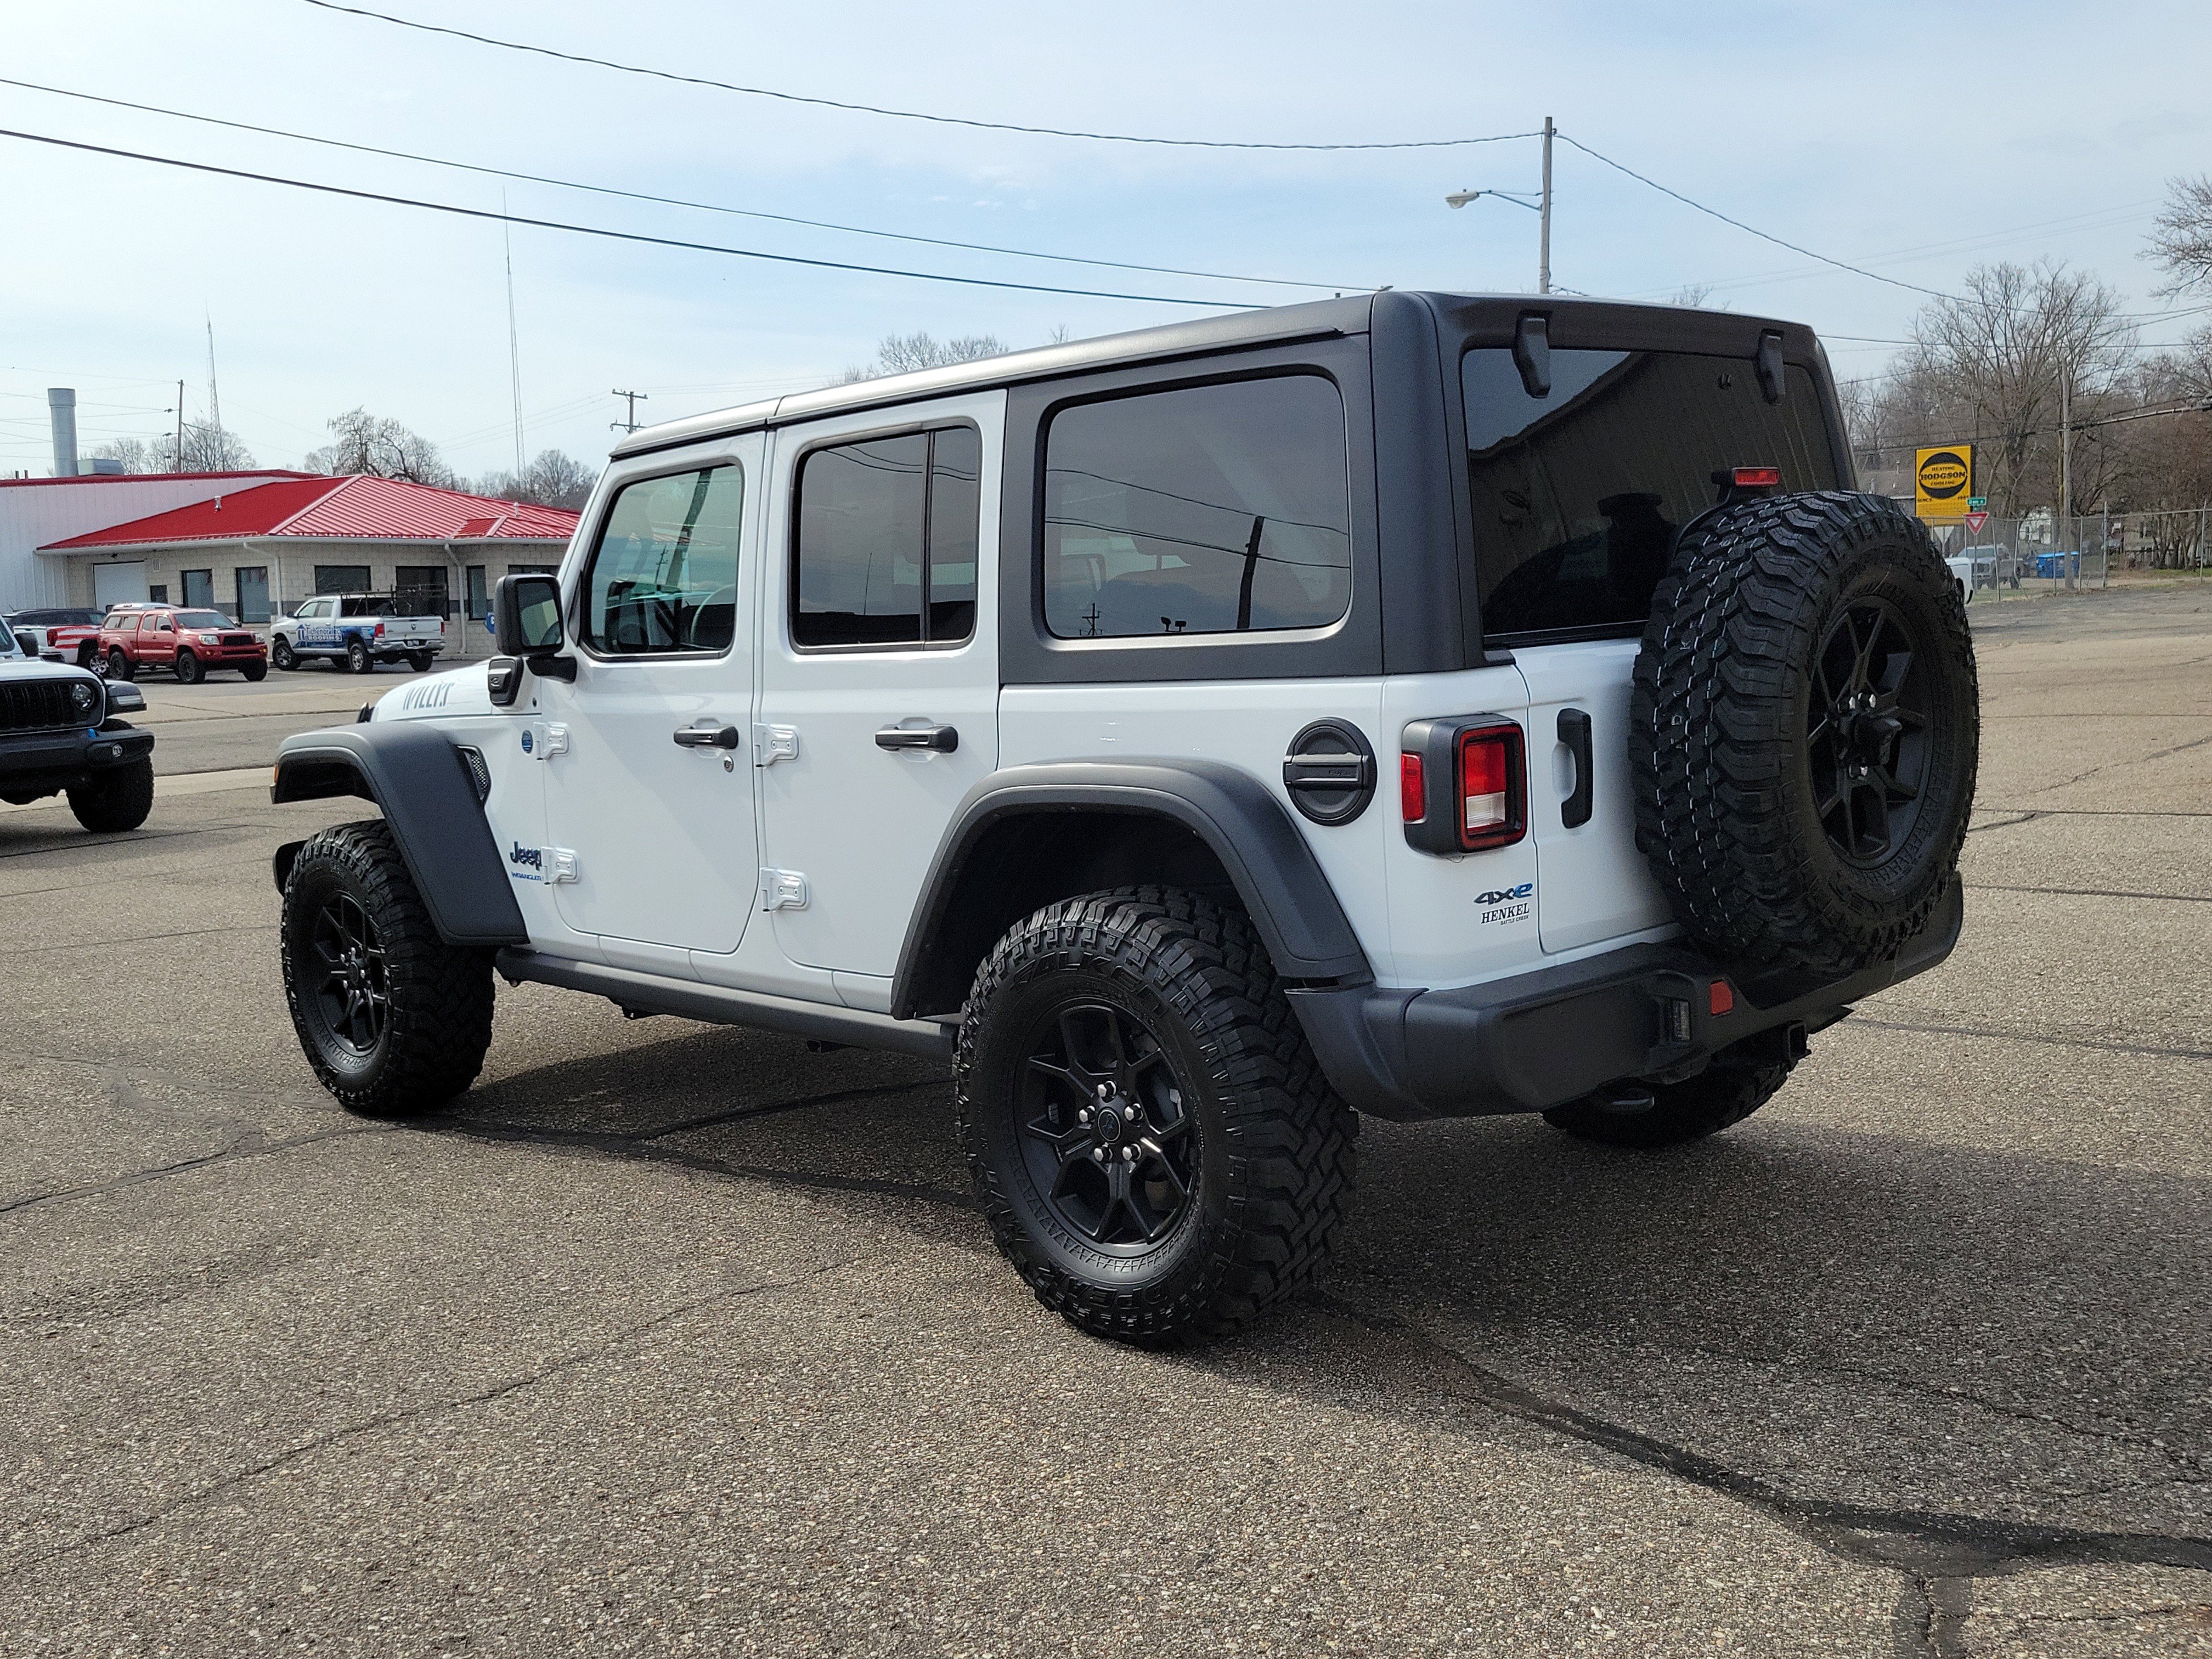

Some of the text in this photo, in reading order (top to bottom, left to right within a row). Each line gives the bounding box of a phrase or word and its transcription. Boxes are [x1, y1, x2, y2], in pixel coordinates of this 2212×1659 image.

[1921, 471, 1966, 480] HODGSON
[509, 840, 542, 871] Jeep
[511, 871, 542, 882] WRANGLER
[1481, 902, 1530, 924] HENKEL
